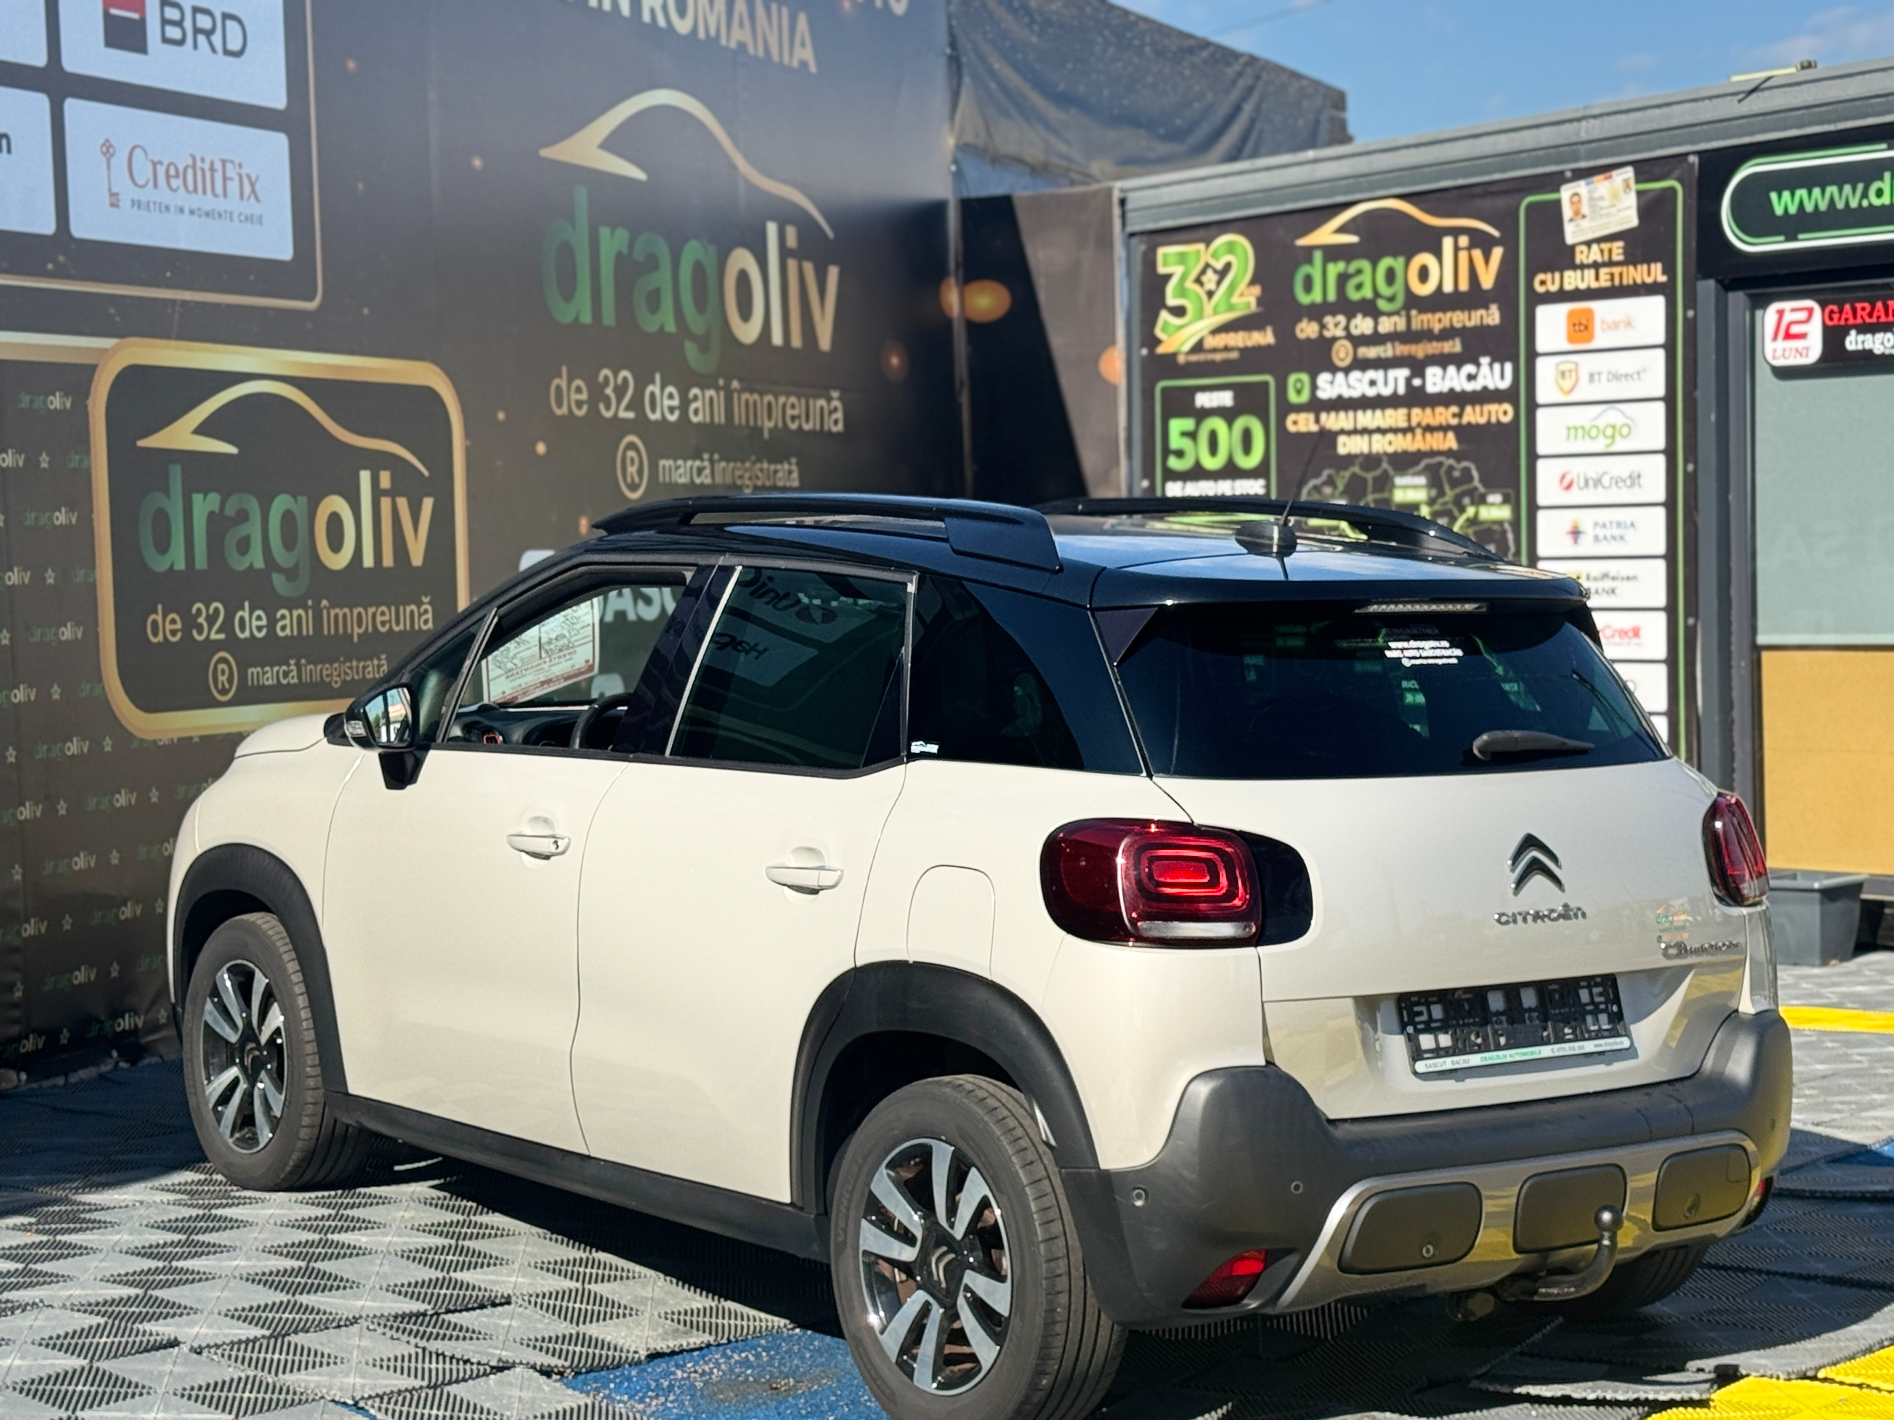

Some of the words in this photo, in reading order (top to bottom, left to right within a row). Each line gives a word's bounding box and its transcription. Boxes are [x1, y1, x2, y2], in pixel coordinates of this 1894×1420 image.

[160, 0, 248, 58] BRD
[126, 143, 262, 204] CreditFix
[1769, 170, 1894, 217] www.d
[130, 198, 172, 216] PRIETEN
[188, 206, 236, 222] MOMENTE
[237, 210, 264, 227] CHEIE
[1574, 240, 1626, 265] RATE
[541, 184, 840, 375] dragoliv
[1293, 234, 1504, 314] dragoliv
[1533, 271, 1561, 294] CU
[1562, 262, 1668, 291] BULETINUL
[1294, 317, 1321, 340] de
[1322, 314, 1348, 338] 32
[1349, 313, 1375, 336] de
[1376, 311, 1407, 335] ani
[1409, 303, 1501, 335] împreună
[1571, 317, 1590, 333] tbi
[1600, 315, 1635, 333] bank
[1771, 306, 1815, 342] 12
[1771, 346, 1810, 360] LUNI
[1844, 328, 1894, 355] drago
[1315, 367, 1411, 400] SASCUT
[1424, 355, 1514, 394] BACĂU
[549, 365, 589, 418] de
[597, 367, 636, 419] 32
[643, 371, 681, 423] de
[687, 378, 725, 426] ani
[730, 379, 845, 440] împreună
[1285, 412, 1319, 433] CEL
[1355, 408, 1409, 430] MARE
[1409, 405, 1460, 428] PARC
[1461, 402, 1515, 425] AUTO
[1166, 413, 1266, 473] 500
[1336, 434, 1369, 455] DIN
[1566, 422, 1632, 449] mogo
[658, 453, 712, 485] marcă
[1577, 470, 1643, 490] UniCredit
[137, 463, 435, 598] dragoliv
[1593, 520, 1636, 532] PATRIA
[1594, 534, 1627, 544] BANK
[146, 603, 183, 644] de
[191, 602, 227, 642] 32
[234, 600, 268, 639] de
[275, 598, 315, 637] ani
[320, 595, 435, 644] împreună
[247, 659, 299, 687] marcă
[300, 654, 389, 690] înregistrată
